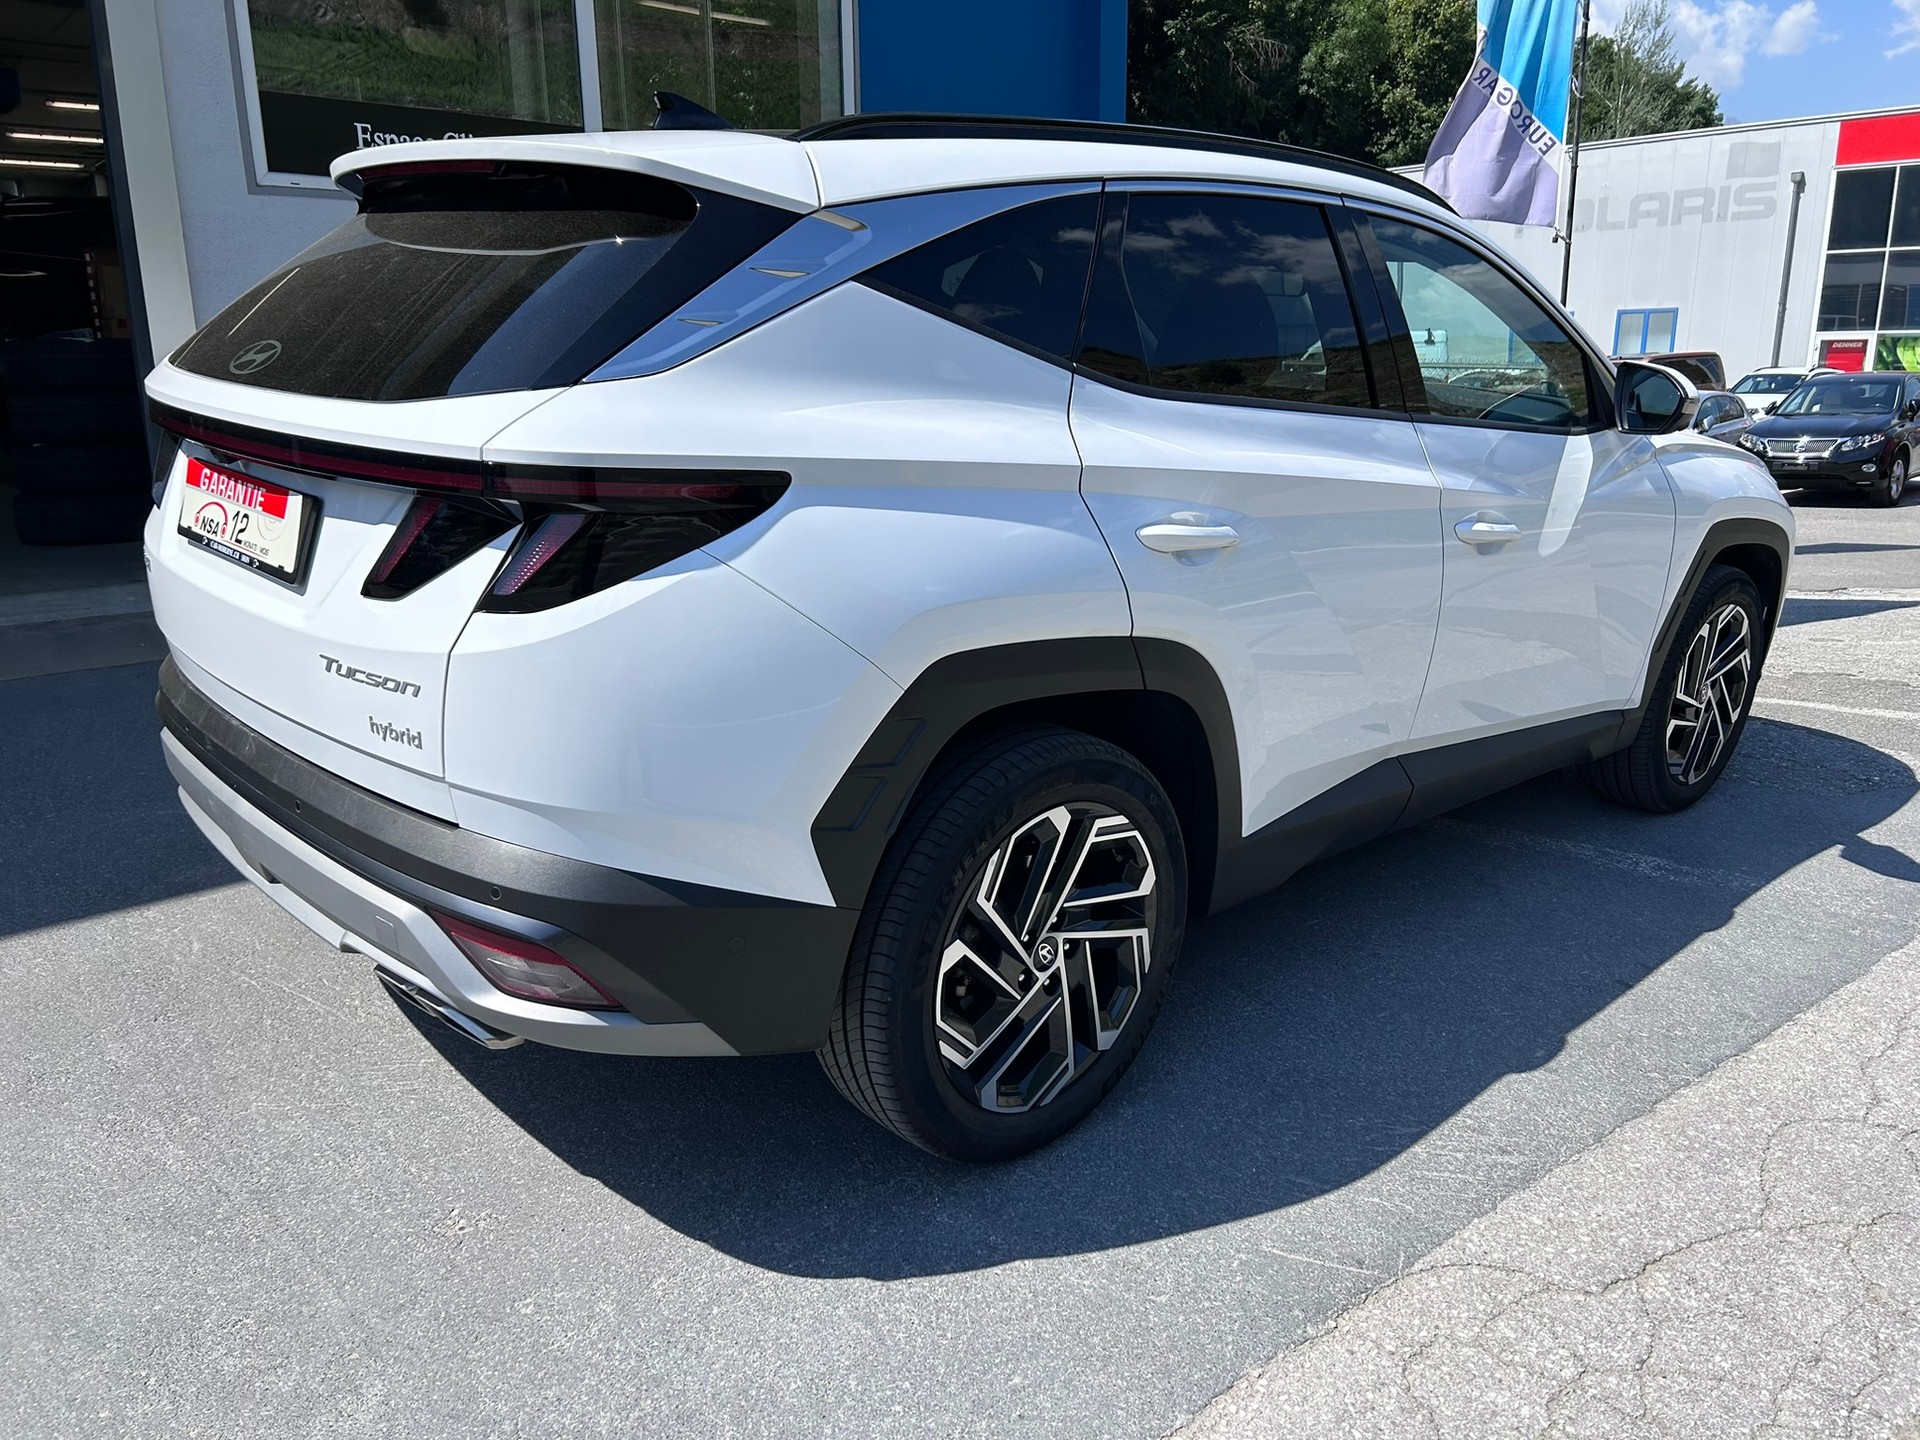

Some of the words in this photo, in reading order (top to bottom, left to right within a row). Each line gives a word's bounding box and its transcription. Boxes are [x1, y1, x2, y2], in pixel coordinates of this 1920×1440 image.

[1559, 181, 1778, 234] OLARIS
[200, 468, 265, 511] GARANTIE
[200, 516, 219, 537] NSA
[230, 510, 250, 545] 12
[368, 715, 423, 750] hybrid
